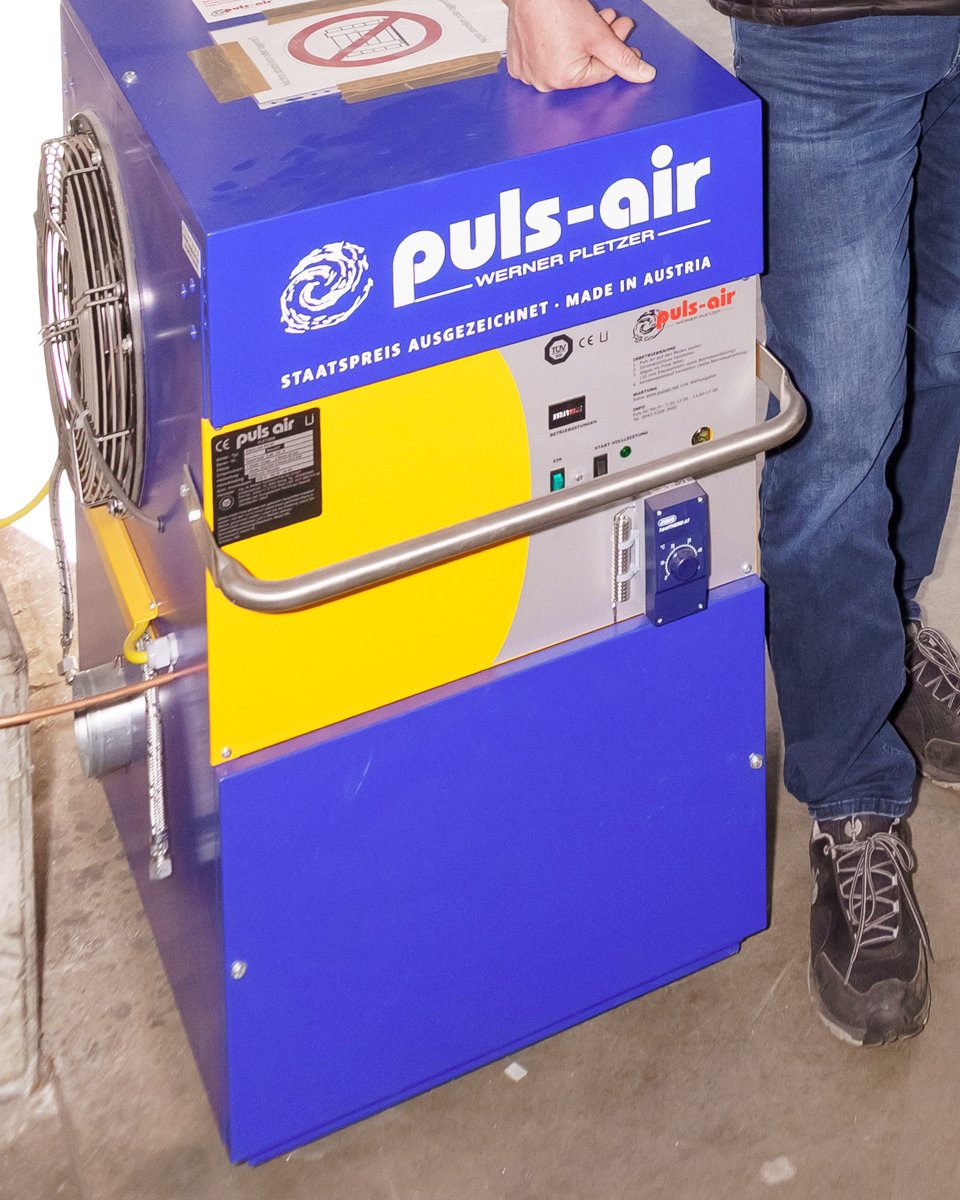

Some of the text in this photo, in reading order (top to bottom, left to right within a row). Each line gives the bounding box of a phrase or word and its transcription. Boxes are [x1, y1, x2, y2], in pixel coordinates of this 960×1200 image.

[393, 144, 711, 308] puls-air
[475, 230, 655, 288] WERNER PLETZER
[281, 256, 712, 389] STAATSPREIS AUSGEZEICHNET MADE IN AUSTRIA
[655, 287, 736, 330] puls-air
[215, 438, 230, 453] CE
[236, 417, 295, 450] puls air
